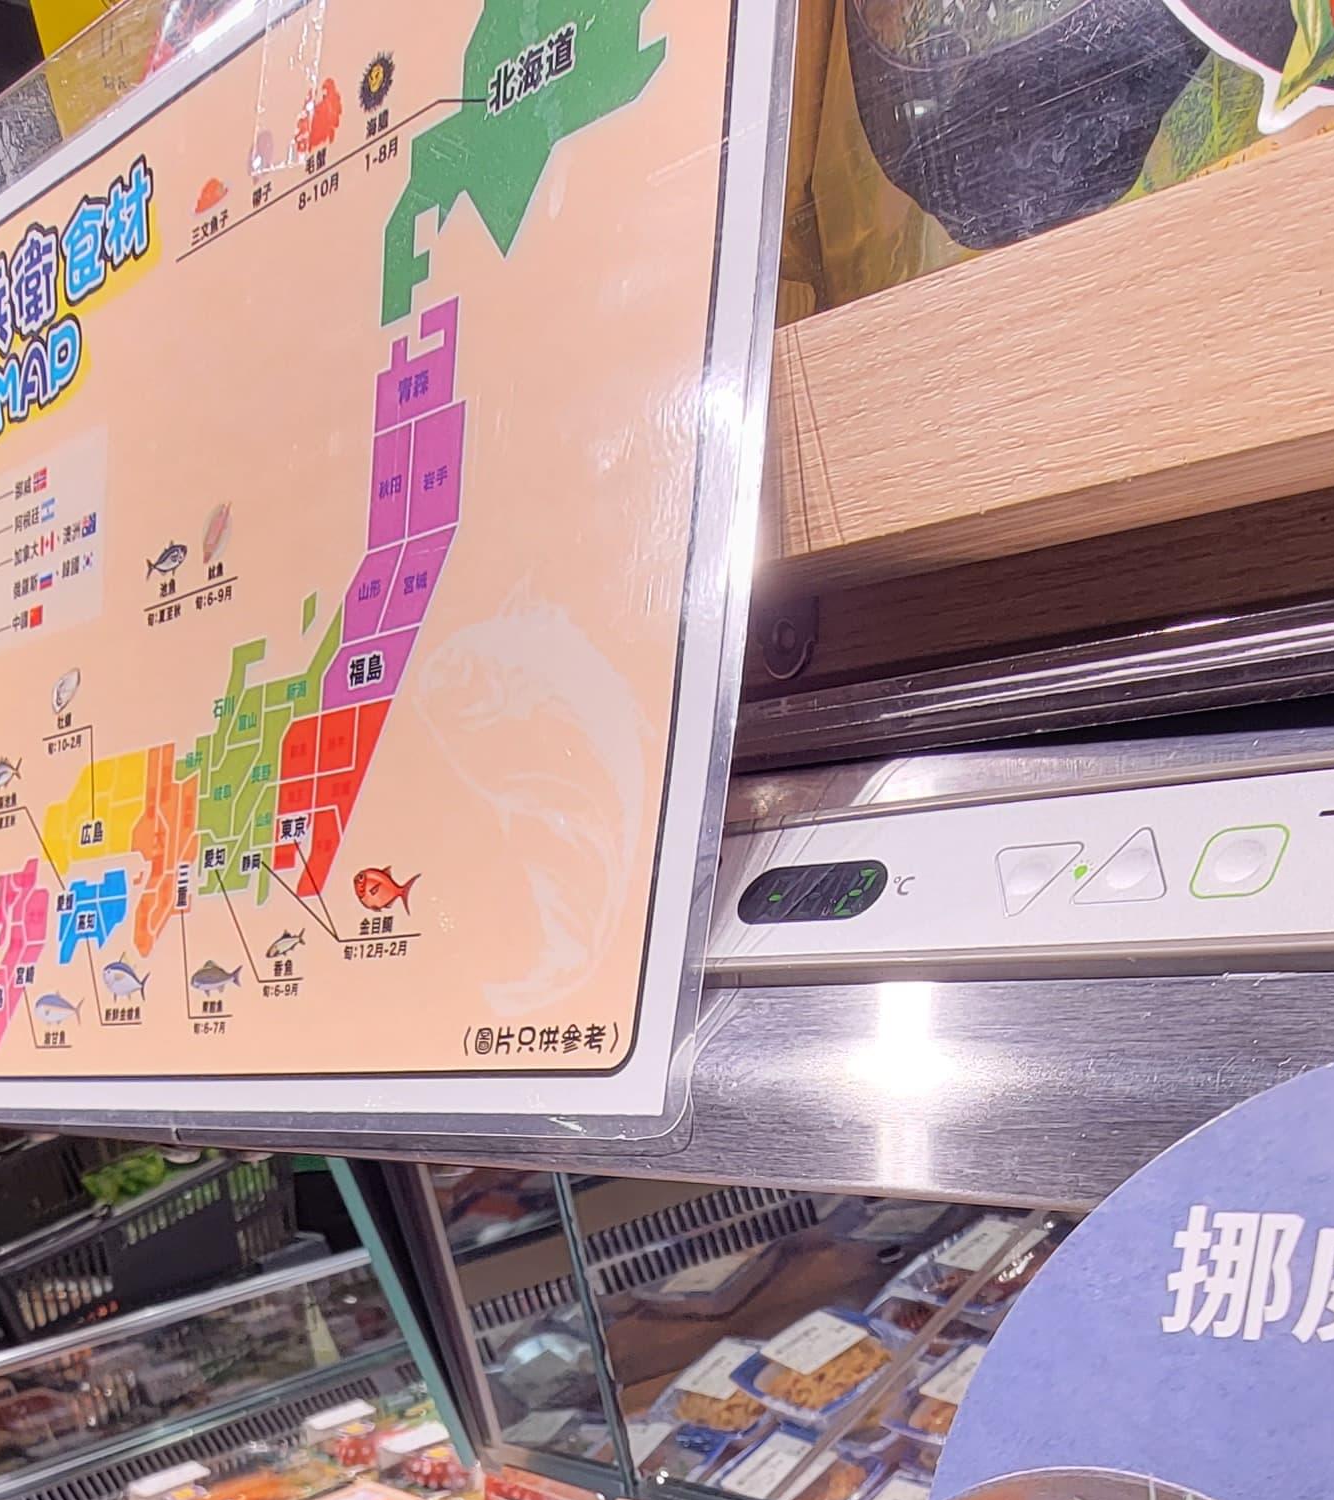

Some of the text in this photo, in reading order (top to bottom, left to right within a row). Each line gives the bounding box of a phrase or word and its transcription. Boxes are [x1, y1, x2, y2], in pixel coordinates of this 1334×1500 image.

[488, 26, 576, 113] 北海道
[364, 136, 399, 172] 1-8月
[298, 172, 340, 212] 8-10月
[191, 210, 229, 247] 三文魚子
[397, 369, 429, 404] 青森
[379, 474, 402, 499] 秋田
[423, 465, 448, 492] 岩手
[14, 506, 39, 533] 阿根廷
[14, 543, 39, 566] 加拿大
[358, 579, 382, 601] 山形
[403, 572, 428, 596] 宮城
[349, 653, 382, 686] 福島
[213, 696, 235, 718] 石川
[237, 712, 256, 731] 富山
[80, 821, 103, 845] 広島
[280, 816, 306, 839] 東京
[204, 848, 225, 868] 愛知
[177, 864, 189, 907] 三重
[77, 914, 95, 930] 高知
[343, 941, 407, 960] 旬:12月-2月
[273, 959, 293, 977] 香魚
[262, 983, 299, 998] 旬:6-9月
